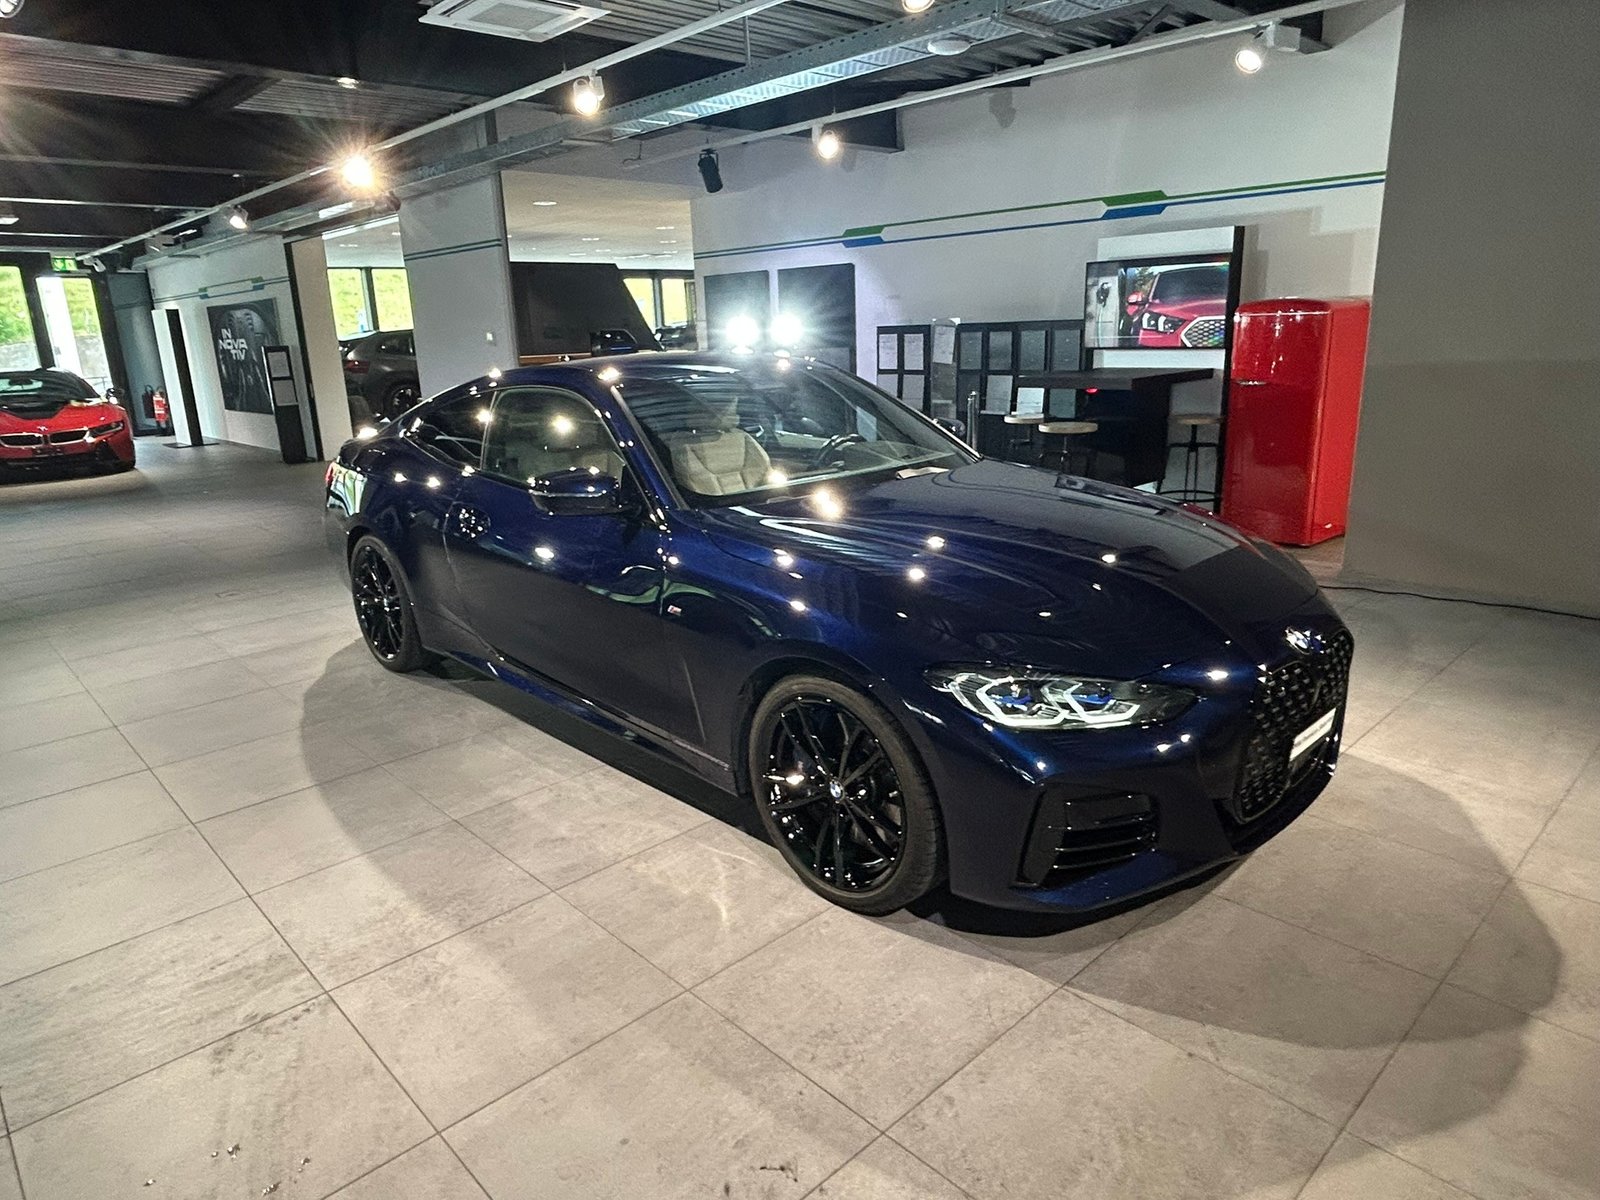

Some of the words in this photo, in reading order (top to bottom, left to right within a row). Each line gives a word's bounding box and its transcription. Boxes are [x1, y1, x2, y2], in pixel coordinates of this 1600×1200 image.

[221, 328, 232, 339] IN
[219, 338, 248, 350] NOVA
[230, 349, 246, 360] TIV
